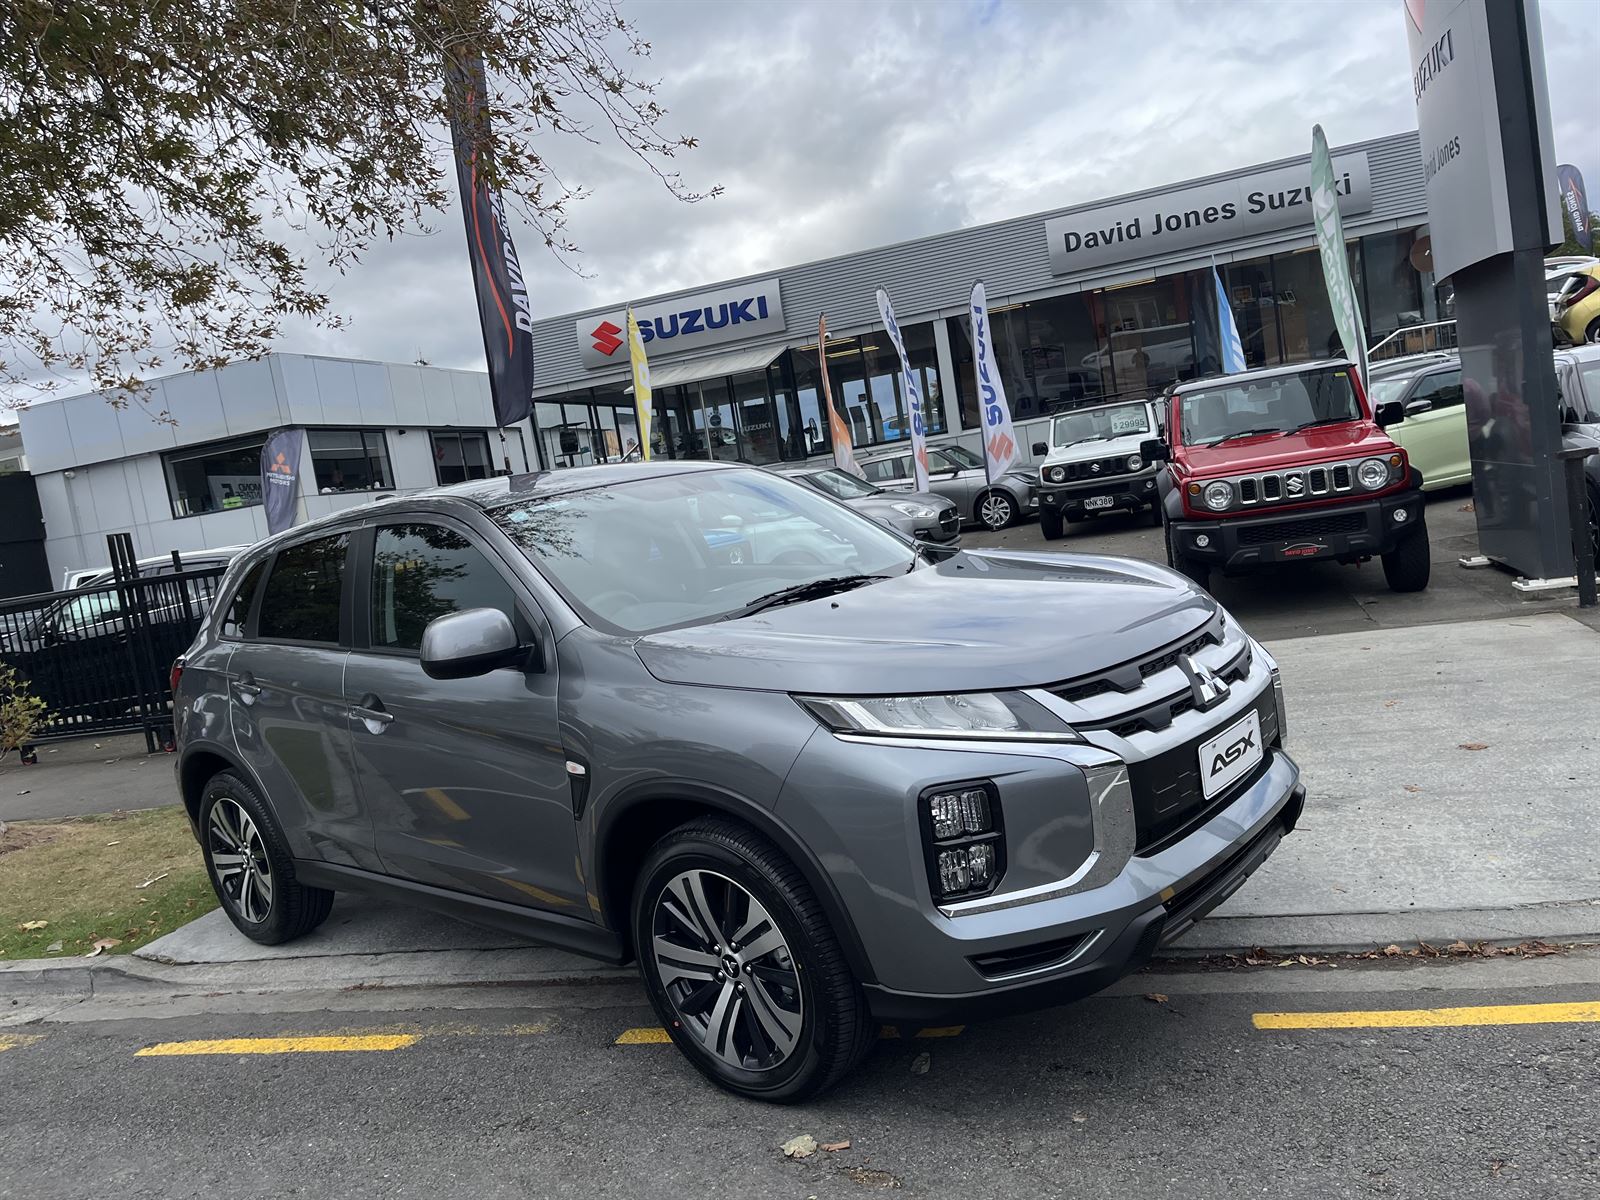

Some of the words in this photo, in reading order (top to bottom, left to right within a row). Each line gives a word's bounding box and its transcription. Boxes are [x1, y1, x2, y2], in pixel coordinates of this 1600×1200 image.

[1436, 135, 1461, 171] Jones
[1063, 218, 1142, 253] David
[1151, 201, 1237, 236] Jones
[1247, 172, 1352, 215] Suzi
[636, 295, 769, 344] SUZUKI
[973, 305, 1003, 427] SUZUKI
[743, 421, 771, 432] UZUKI
[269, 478, 290, 487] MOTORS
[1210, 729, 1255, 778] ASX
